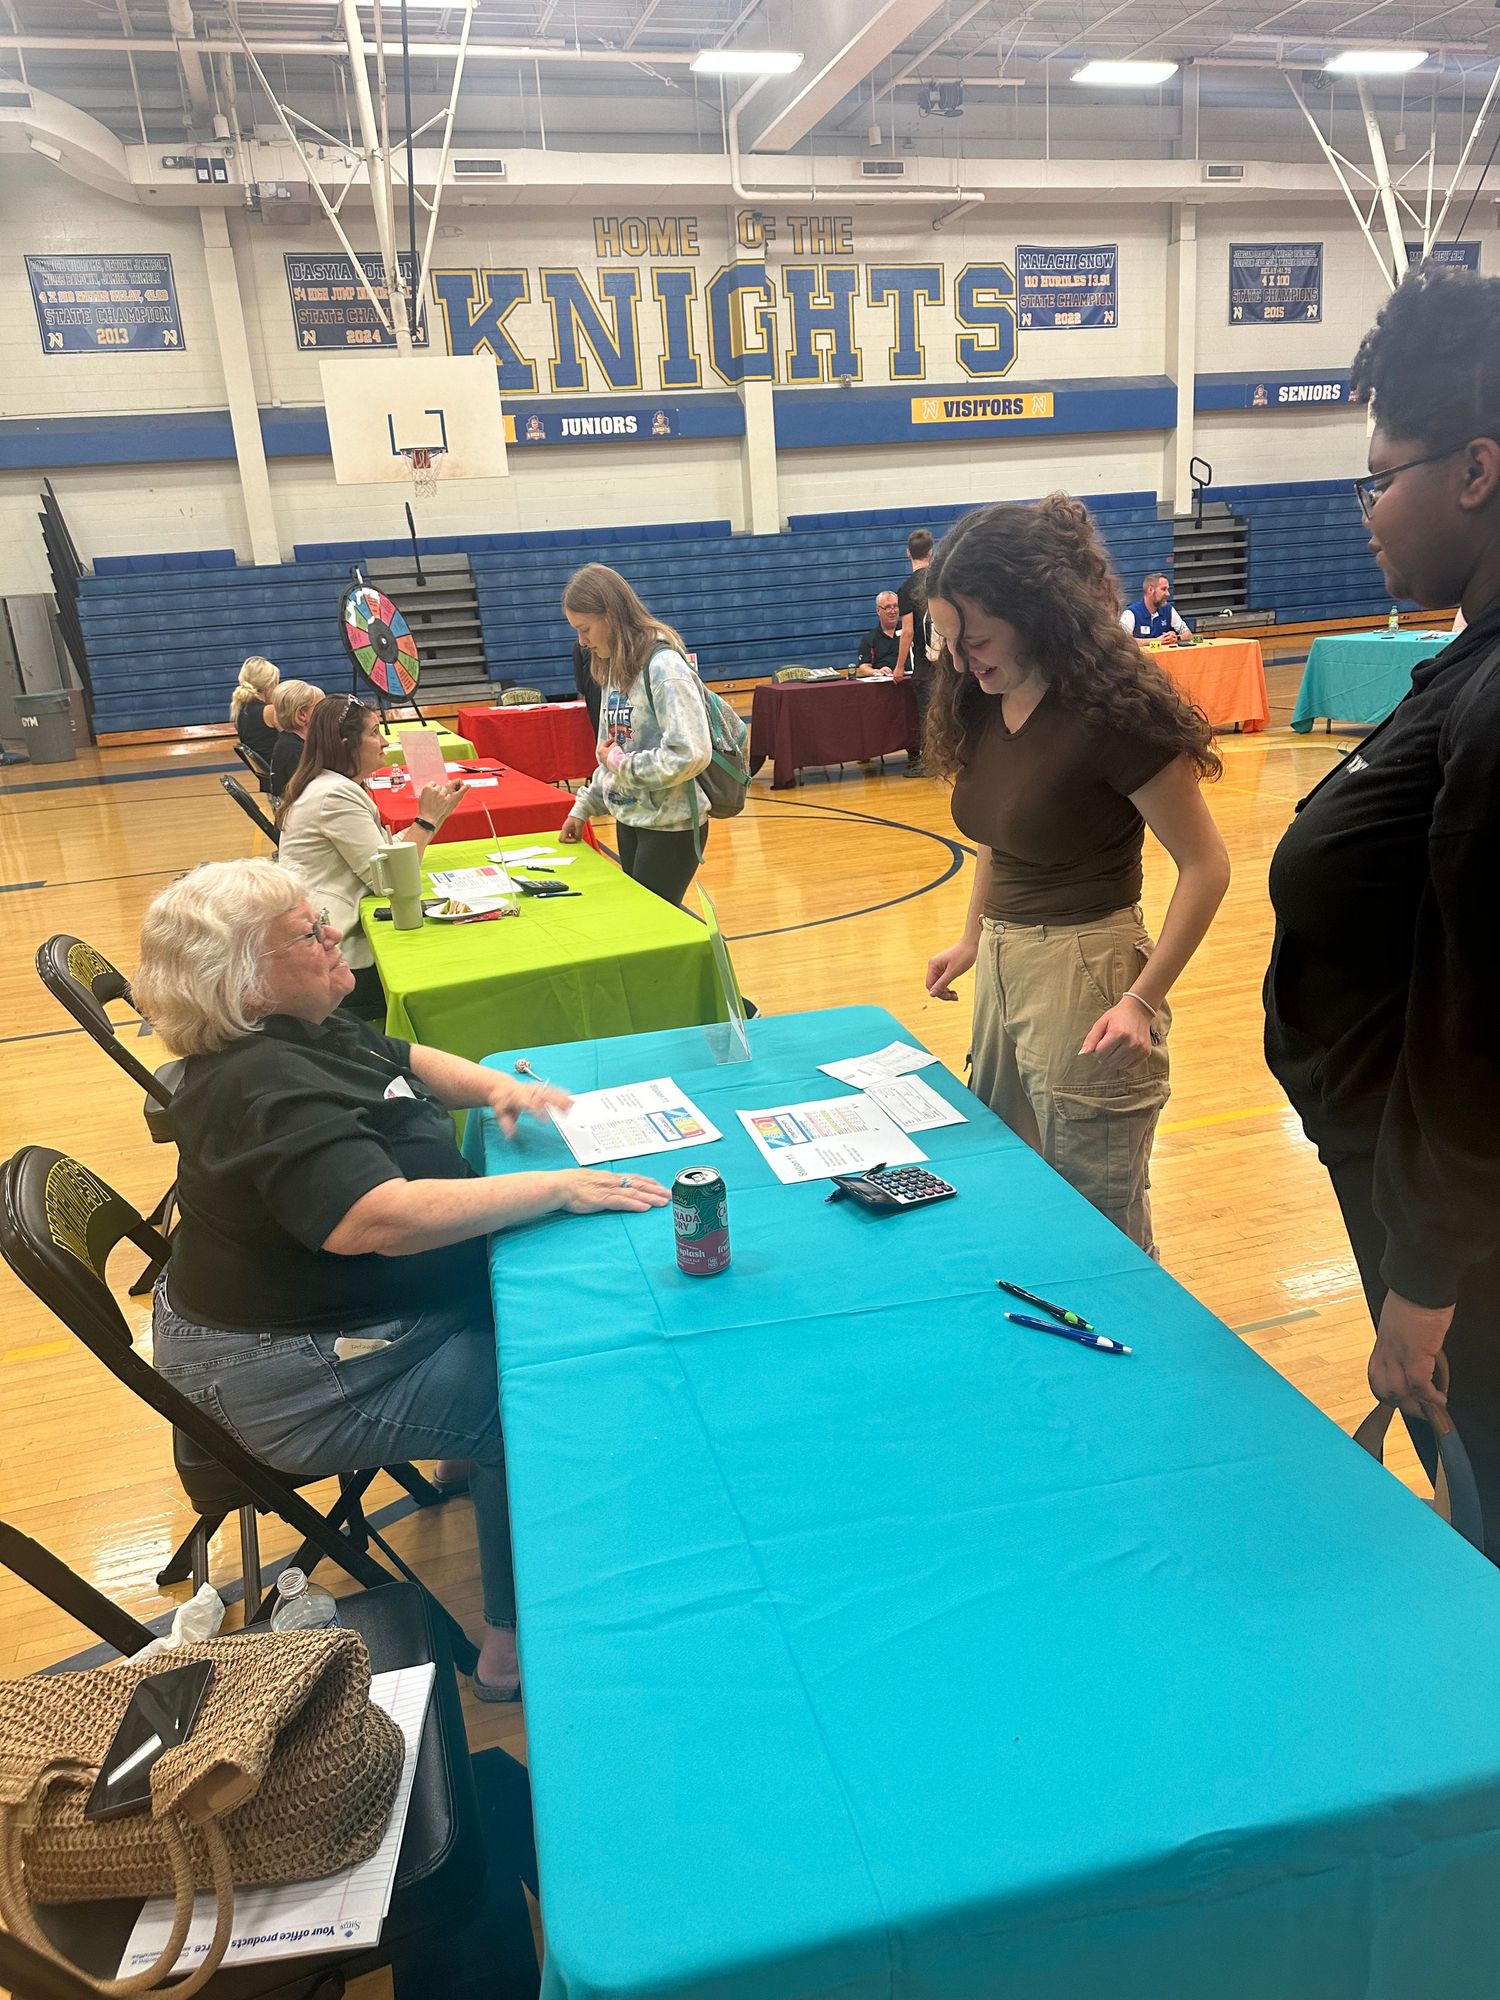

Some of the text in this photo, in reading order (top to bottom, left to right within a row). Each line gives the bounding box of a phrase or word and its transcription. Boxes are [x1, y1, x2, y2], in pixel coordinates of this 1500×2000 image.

[593, 217, 700, 257] HOME
[787, 216, 854, 255] THE
[1020, 253, 1114, 269] MALACHI SNOW
[290, 263, 352, 280] D'ASYIA
[1040, 275, 1087, 287] HURDLES
[1261, 275, 1290, 286] 4 X 100
[331, 286, 355, 300] JUMP
[1021, 293, 1114, 307] STATE CHAMPION
[1232, 288, 1318, 303] STATE CHAMPIONS
[44, 307, 172, 325] STATE CHAMPION
[299, 309, 344, 324] STATE
[1055, 312, 1081, 325] 2022
[1264, 307, 1285, 318] 2015
[430, 262, 1018, 393] KNIGHTS
[97, 328, 129, 344] 2013
[346, 329, 382, 343] 2024
[1278, 384, 1341, 402] SENIORS
[943, 398, 1024, 418] VISITORS
[561, 416, 638, 436] JUNIORS
[674, 1210, 702, 1224] NADA
[279, 1929, 310, 1941] office
[311, 1926, 335, 1937] Your
[231, 1932, 279, 1948] products
